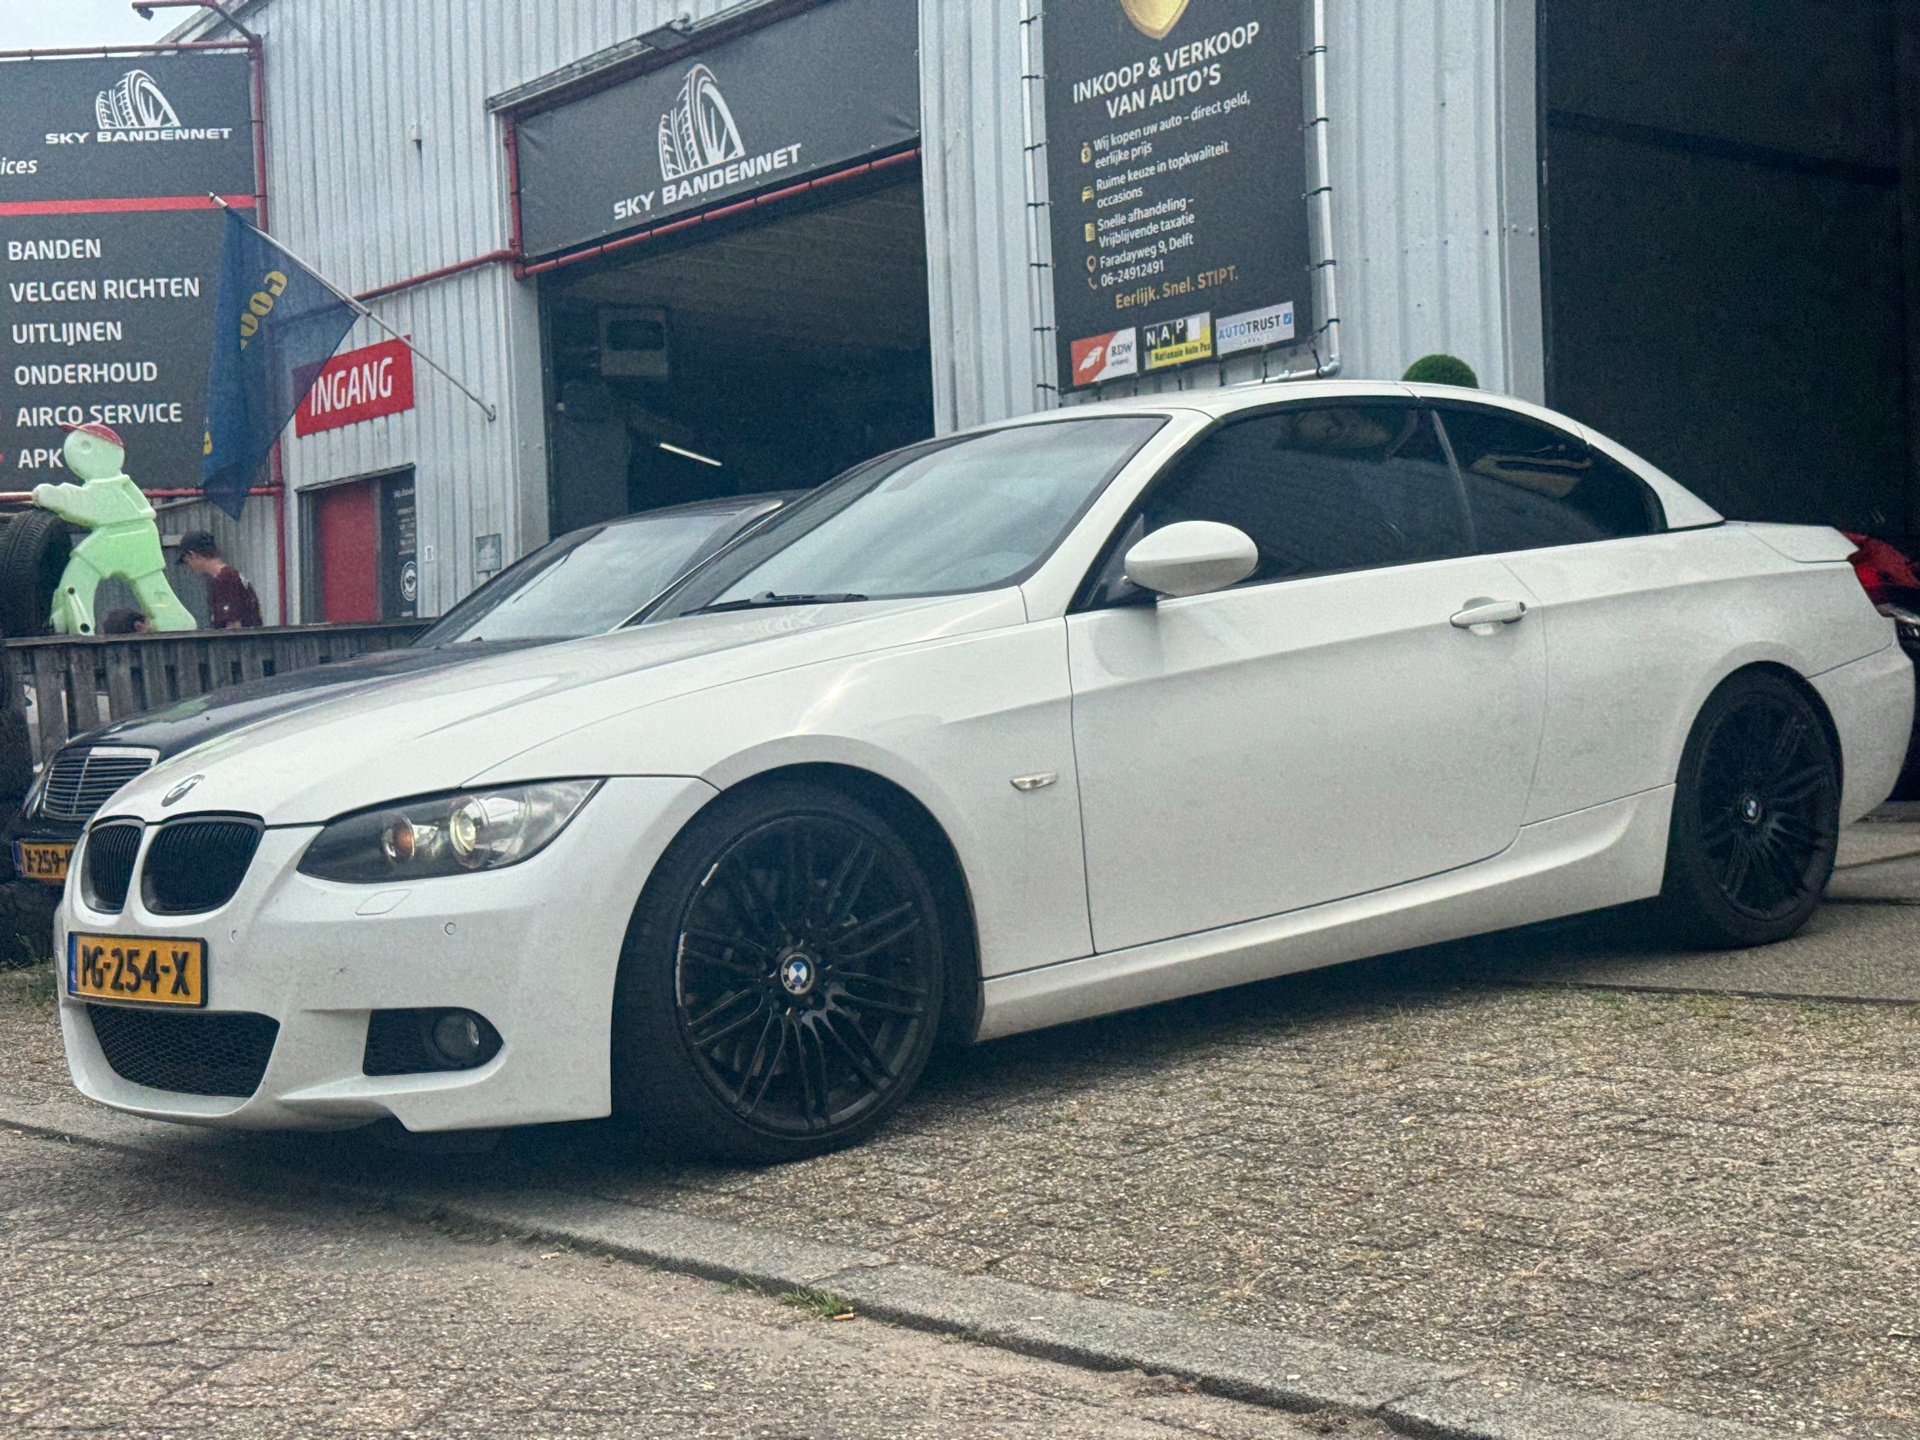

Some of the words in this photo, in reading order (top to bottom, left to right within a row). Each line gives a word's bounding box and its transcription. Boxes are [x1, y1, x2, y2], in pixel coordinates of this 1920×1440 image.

[1073, 62, 1144, 103] INKOOP
[1148, 56, 1161, 78] &
[1164, 21, 1259, 72] VERKOOP
[1106, 89, 1145, 119] VAN
[1149, 63, 1221, 106] AUTO'S
[1093, 135, 1109, 151] Wij
[1110, 128, 1142, 147] kopen
[1143, 123, 1158, 136] uw
[1159, 115, 1182, 132] auto
[1191, 102, 1222, 121] direct
[1223, 91, 1250, 114] geld,
[45, 132, 89, 144] SKY
[97, 128, 233, 143] BANDENNET
[0, 157, 38, 175] ices
[1095, 149, 1129, 169] eerlijke
[1131, 141, 1153, 162] prijs
[1096, 173, 1126, 191] Ruime
[1127, 165, 1156, 183] keuze
[1157, 160, 1166, 173] in
[1168, 140, 1229, 171] topkwaliteit
[614, 190, 655, 221] SKY
[662, 142, 801, 205] BANDENNET
[1097, 186, 1143, 209] occasions
[1097, 213, 1126, 231] Snelle
[1128, 198, 1187, 223] afhandeling
[1099, 223, 1159, 248] Vrijblijvende
[1160, 212, 1195, 231] taxatie
[8, 238, 102, 261] BANDEN
[1100, 246, 1157, 269] Faradayweg
[1169, 232, 1194, 250] Delft
[1101, 259, 1164, 287] 06-24912491
[9, 280, 97, 302] VELGEN
[104, 277, 200, 300] RICHTEN
[1115, 286, 1160, 310] Eerlijk.
[1162, 276, 1195, 298] Snel.
[1198, 265, 1239, 289] STIPT.
[12, 321, 122, 346] UITLIJNEN
[1218, 314, 1281, 340] AUTOTRUST
[1111, 342, 1133, 357] RDW
[14, 362, 158, 385] ONDERHOUD
[310, 356, 393, 417] INGANG
[16, 406, 83, 428] AIRCO
[90, 403, 182, 424] SERVICE
[18, 448, 64, 469] APK
[81, 944, 190, 996] PG-254-X
